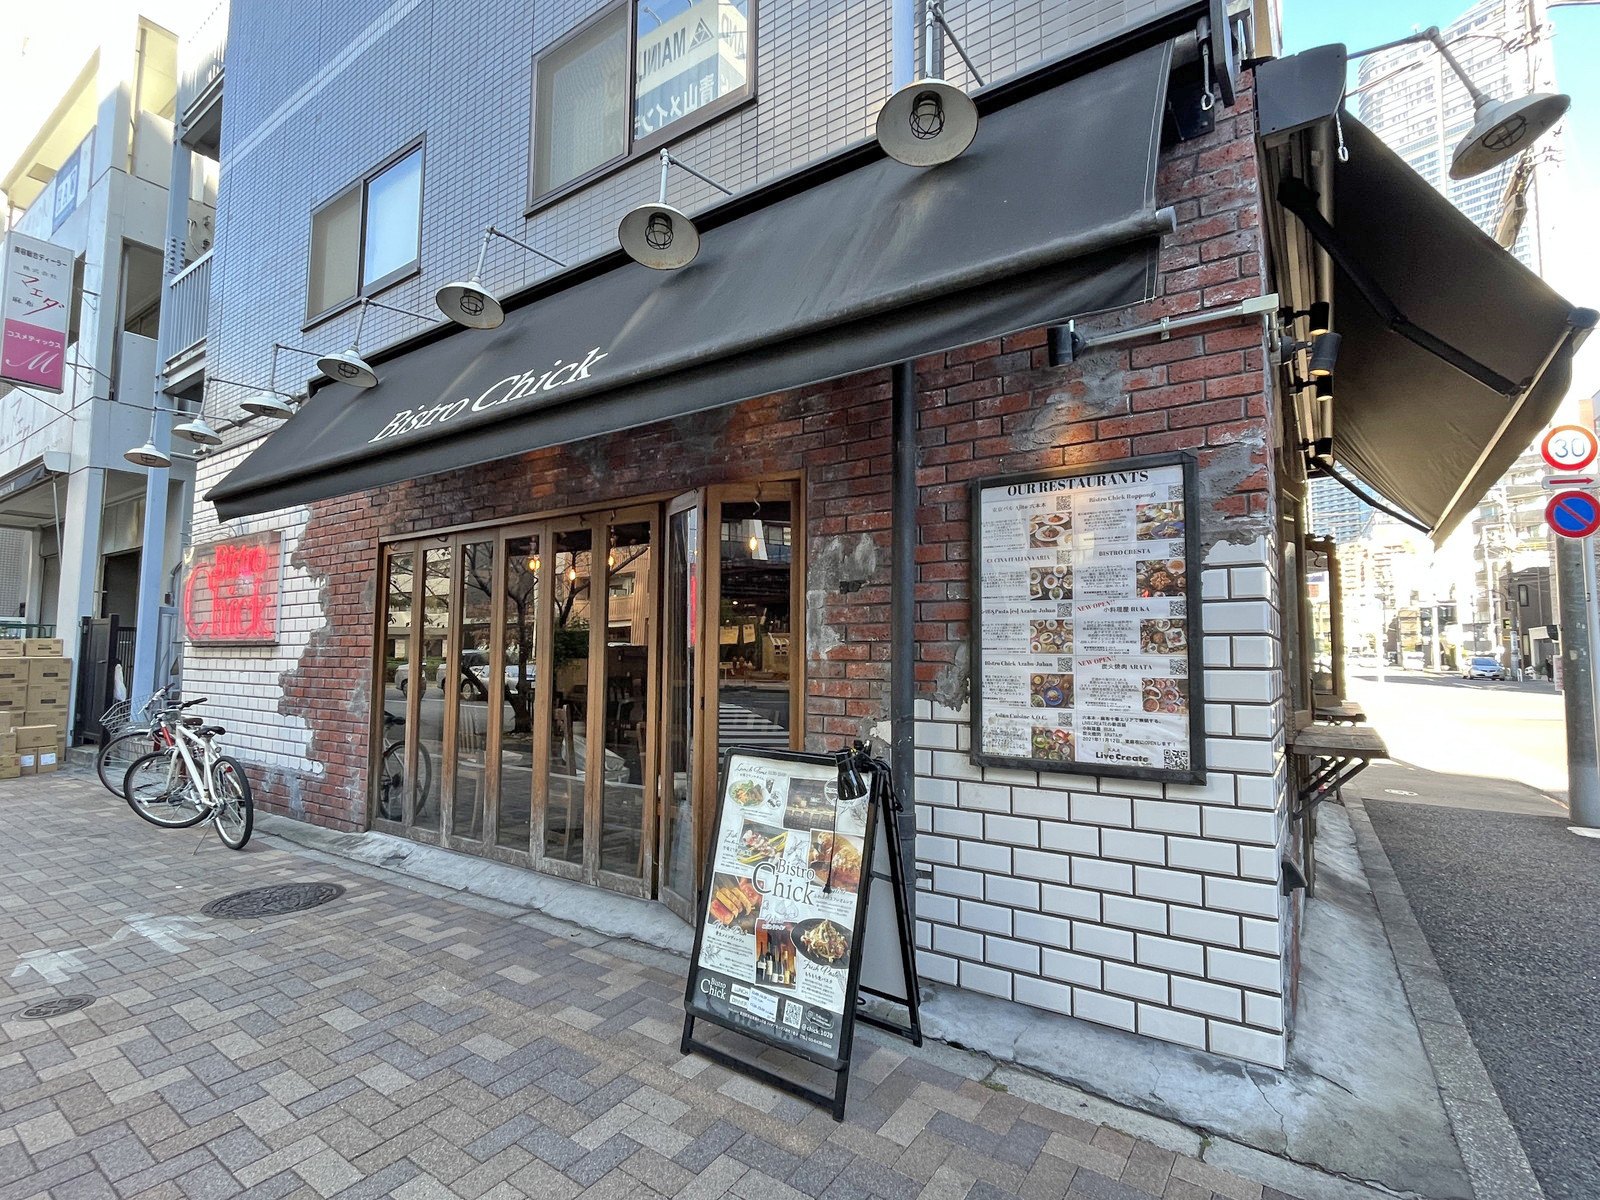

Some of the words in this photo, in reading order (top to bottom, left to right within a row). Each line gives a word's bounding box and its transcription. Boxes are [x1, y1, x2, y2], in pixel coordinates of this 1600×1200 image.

[7, 330, 62, 349] コスメティックス
[5, 350, 59, 374] M
[368, 398, 470, 444] Bistro
[472, 347, 609, 412] Chick
[1554, 437, 1586, 459] 30
[1007, 483, 1036, 497] OUR
[1039, 470, 1149, 493] RESTAURANTS
[1106, 493, 1126, 501] Chick
[1077, 604, 1092, 612] NEW
[778, 858, 815, 881] Bistro
[753, 862, 815, 906] Chick
[700, 978, 726, 1001] Chick
